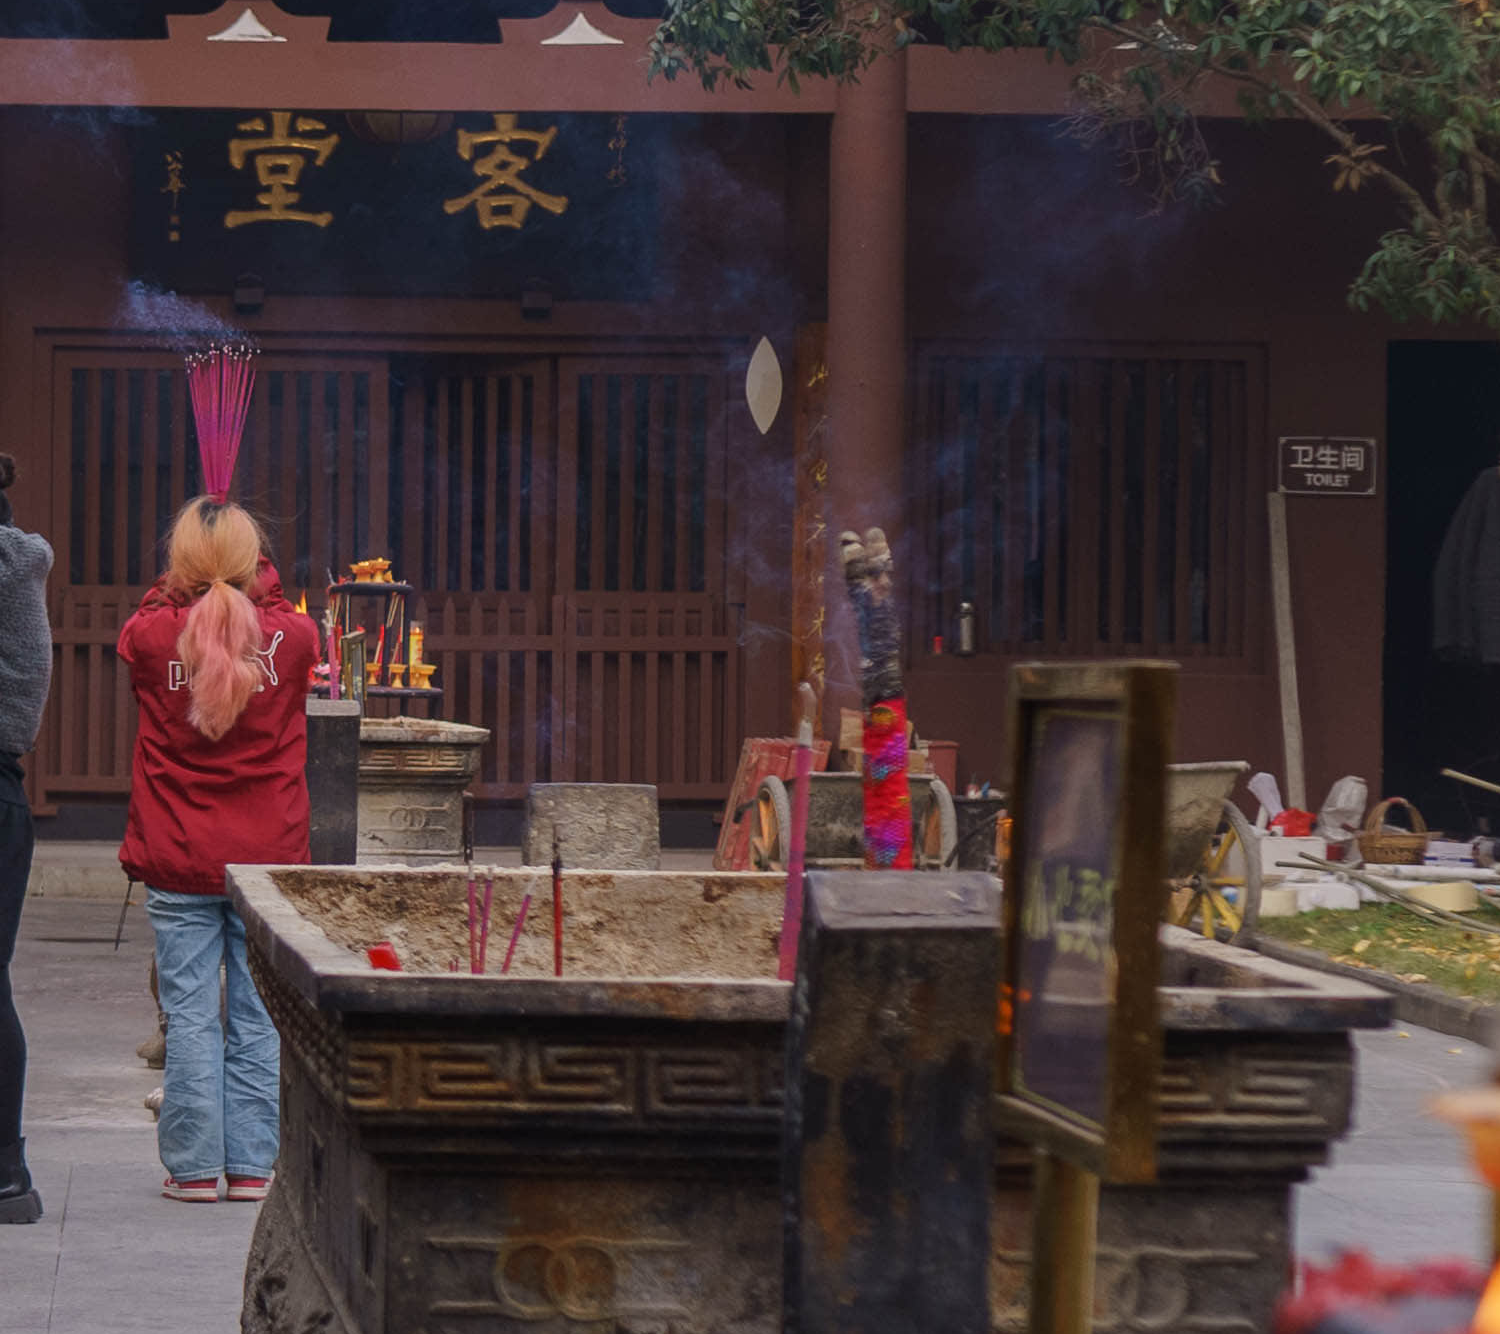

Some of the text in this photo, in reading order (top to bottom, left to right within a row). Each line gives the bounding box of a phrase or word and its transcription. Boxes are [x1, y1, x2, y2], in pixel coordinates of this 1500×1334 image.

[1289, 445, 1365, 471] 卫生间
[1304, 473, 1351, 487] TOILET
